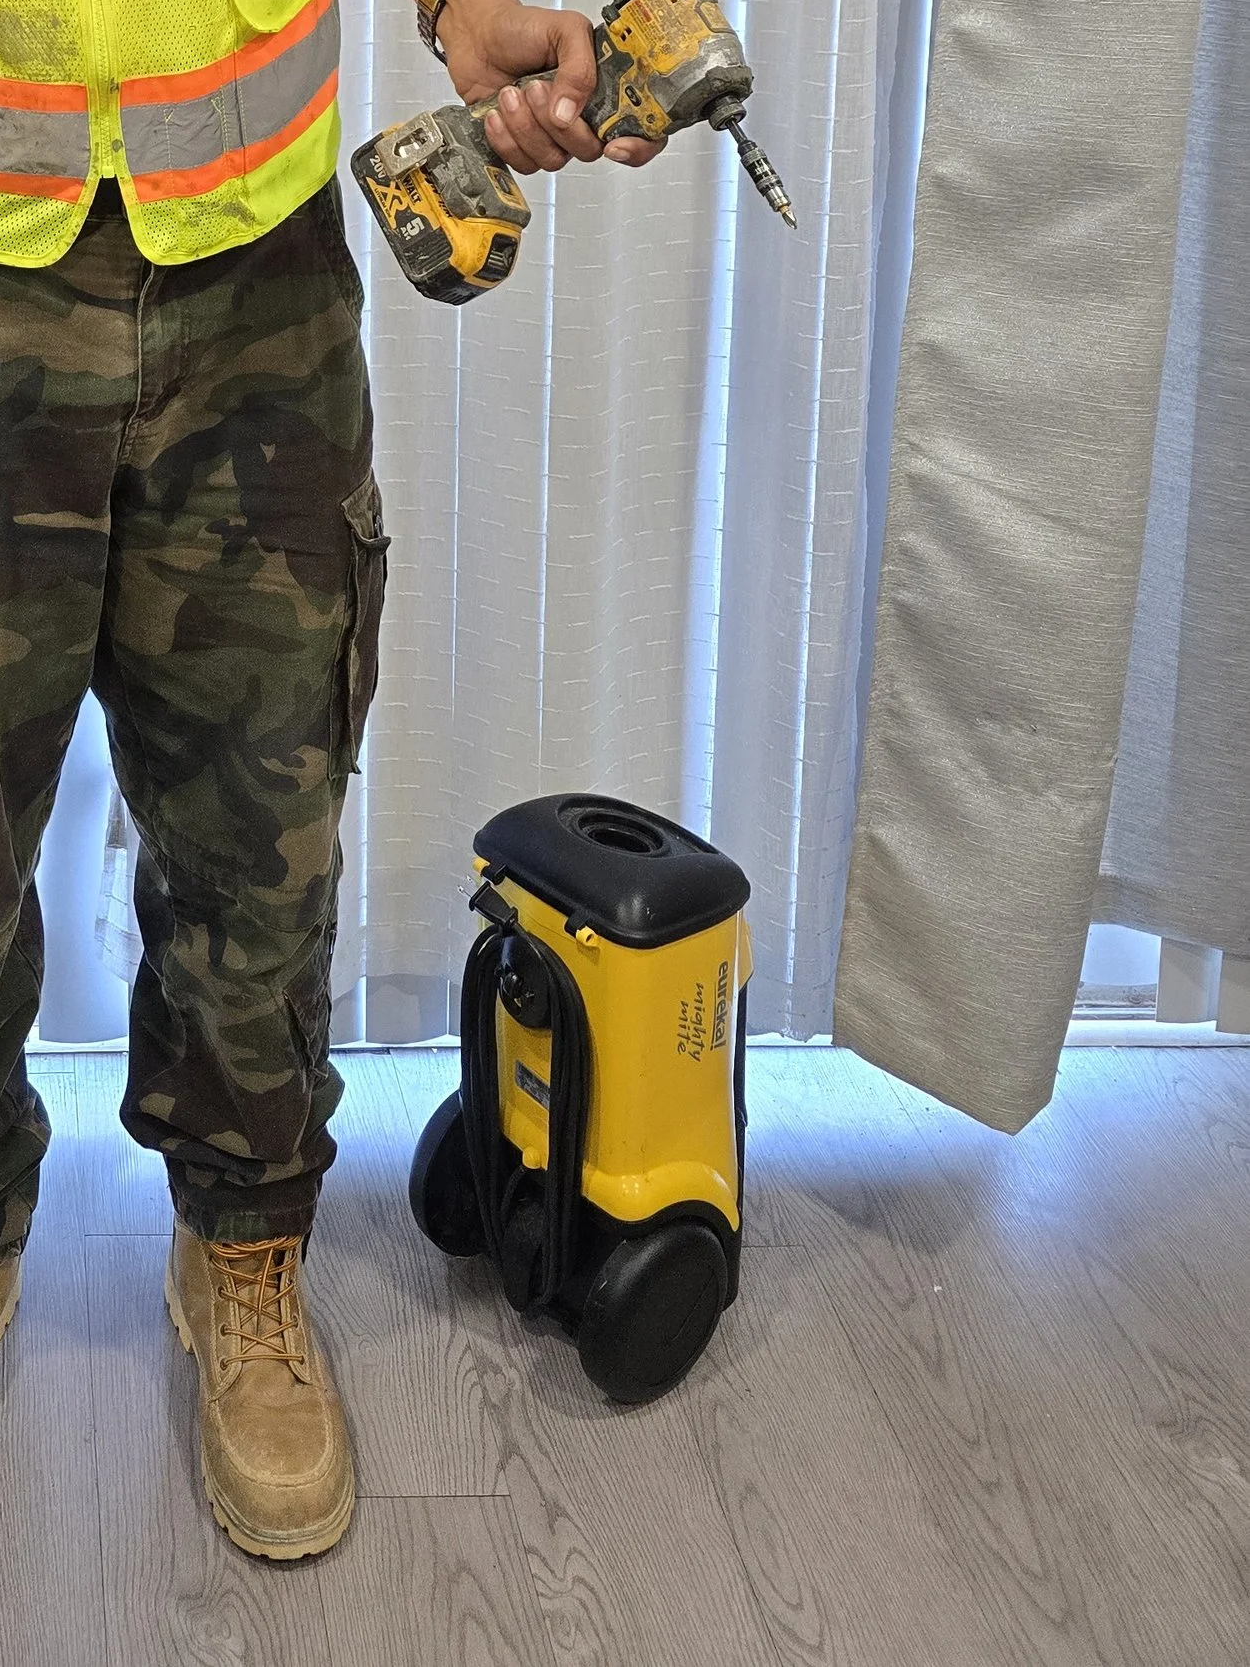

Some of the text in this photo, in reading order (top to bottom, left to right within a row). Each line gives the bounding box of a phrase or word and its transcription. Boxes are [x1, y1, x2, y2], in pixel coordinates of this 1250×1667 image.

[403, 174, 422, 204] WALT
[406, 217, 425, 236] 5
[676, 1001, 691, 1055] mite
[688, 982, 707, 1062] mighty
